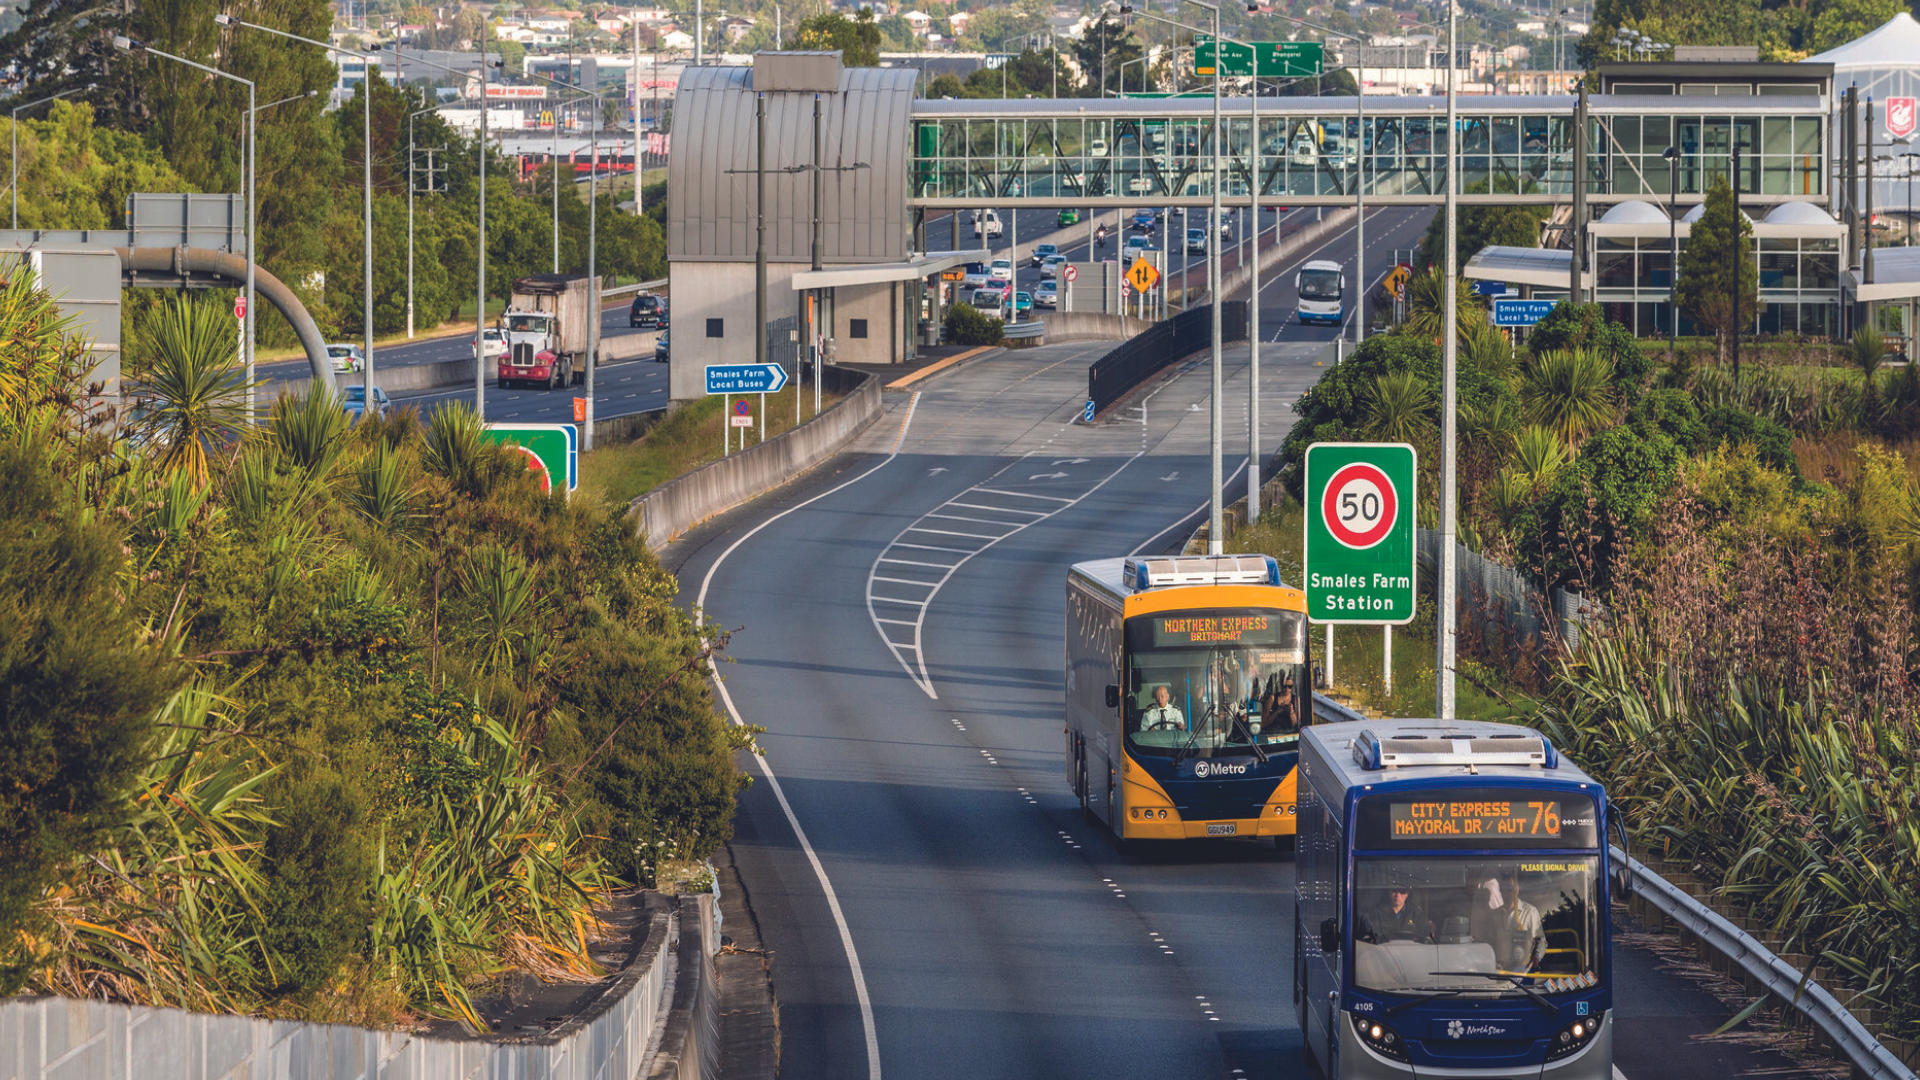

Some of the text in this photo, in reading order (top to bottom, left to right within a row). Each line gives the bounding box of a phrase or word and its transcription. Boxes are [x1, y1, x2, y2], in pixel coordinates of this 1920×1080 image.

[1475, 284, 1480, 294] 2
[710, 369, 765, 379] Smales Farm
[710, 380, 764, 389] Local Buses
[1342, 493, 1379, 521] 50
[1311, 572, 1410, 589] Smales Farm
[1326, 595, 1394, 610] Station
[1164, 616, 1268, 633] NORTHERN EXPRESS
[1190, 631, 1242, 642] BRITOMART
[1211, 763, 1246, 775] Metro
[1411, 802, 1511, 818] CITY EXPRESS
[1528, 802, 1559, 835] 76
[1207, 825, 1235, 835] GGU949
[1395, 819, 1460, 835] MAYORAL
[1464, 819, 1482, 834] DR
[1497, 818, 1527, 834] AUT
[1521, 864, 1544, 872] PLEASE
[1545, 864, 1567, 872] SIGNAL
[1354, 1003, 1373, 1011] 4105
